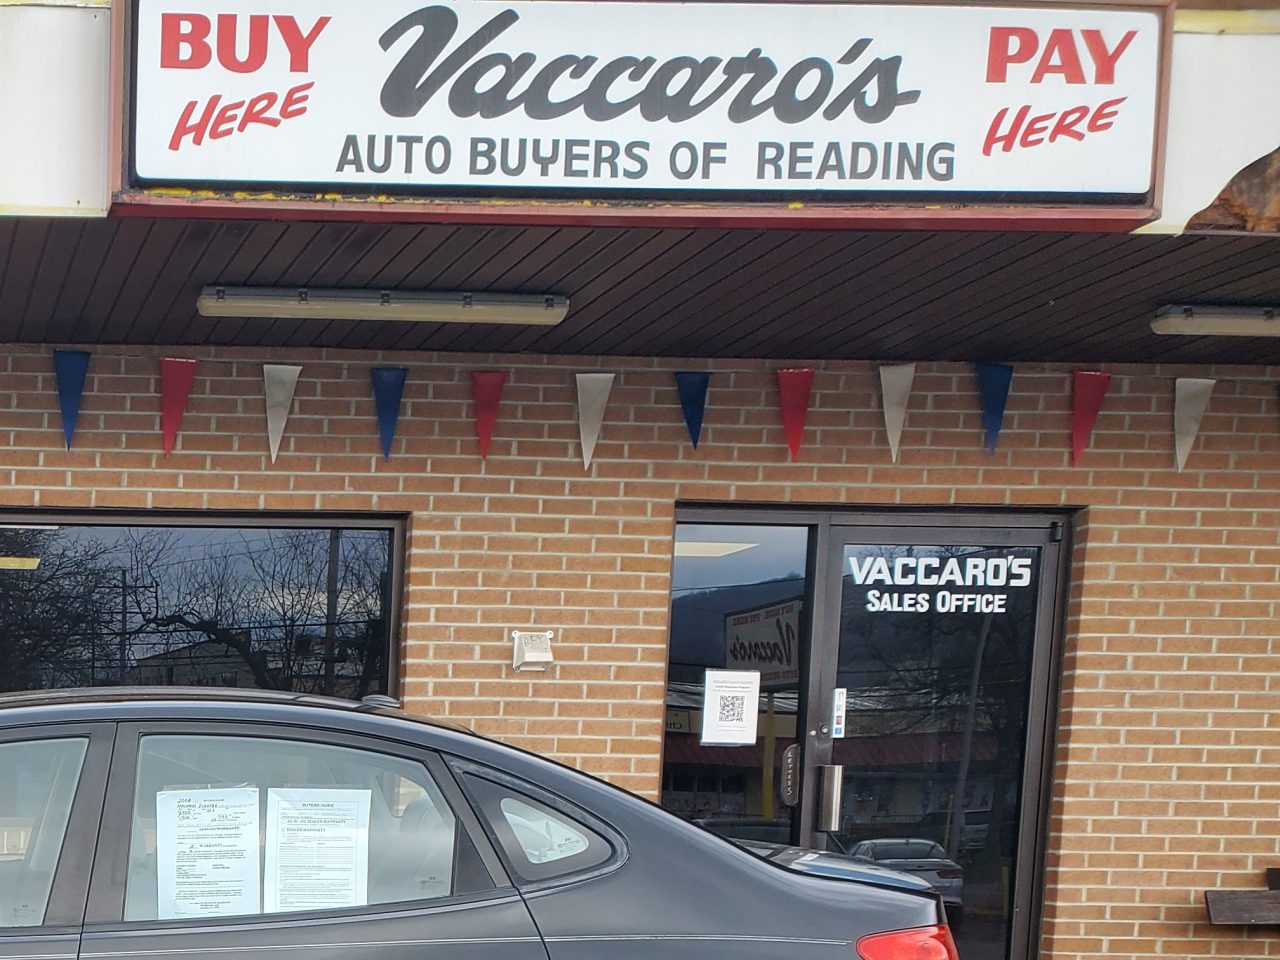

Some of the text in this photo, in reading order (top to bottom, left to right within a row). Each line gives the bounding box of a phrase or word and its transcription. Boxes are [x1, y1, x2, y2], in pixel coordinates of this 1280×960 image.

[160, 12, 332, 74] BUY
[378, 5, 921, 124] Vaccaro's
[985, 26, 1139, 85] PAY
[168, 81, 315, 151] HERE
[982, 96, 1128, 157] HERE
[335, 134, 955, 182] AUTO BUYERS OF READING
[848, 555, 1032, 587] VACCARO'S
[866, 590, 1008, 613] SALES OFFICE
